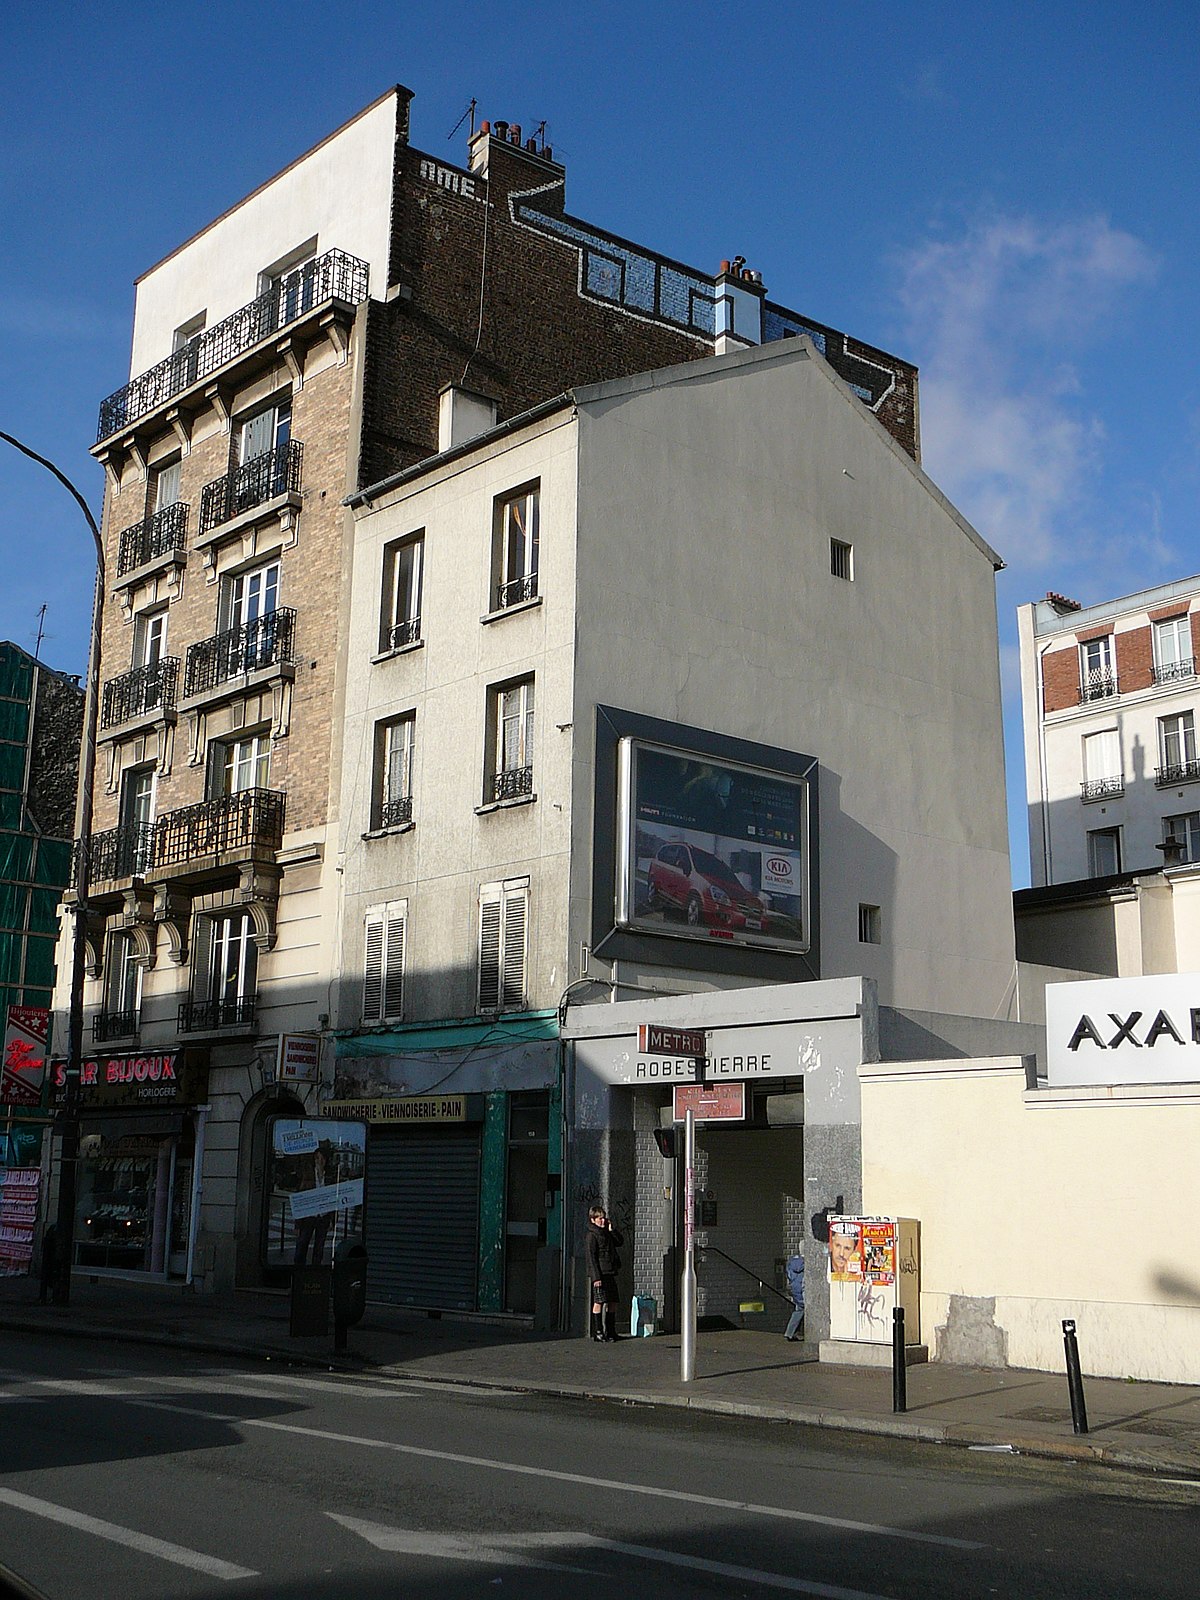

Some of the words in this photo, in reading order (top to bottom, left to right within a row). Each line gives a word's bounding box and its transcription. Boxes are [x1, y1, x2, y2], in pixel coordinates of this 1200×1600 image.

[771, 861, 788, 873] KIA
[11, 1006, 48, 1018] Bijouterie
[651, 1031, 701, 1052] METRO
[106, 1055, 177, 1083] BIJOUX
[138, 1087, 177, 1098] HORLOGERIE
[3, 1094, 40, 1105] Horlogerie
[322, 1104, 377, 1119] SANDWICHERIE
[381, 1102, 436, 1118] VIENNOISERIE
[441, 1101, 461, 1117] PAIN
